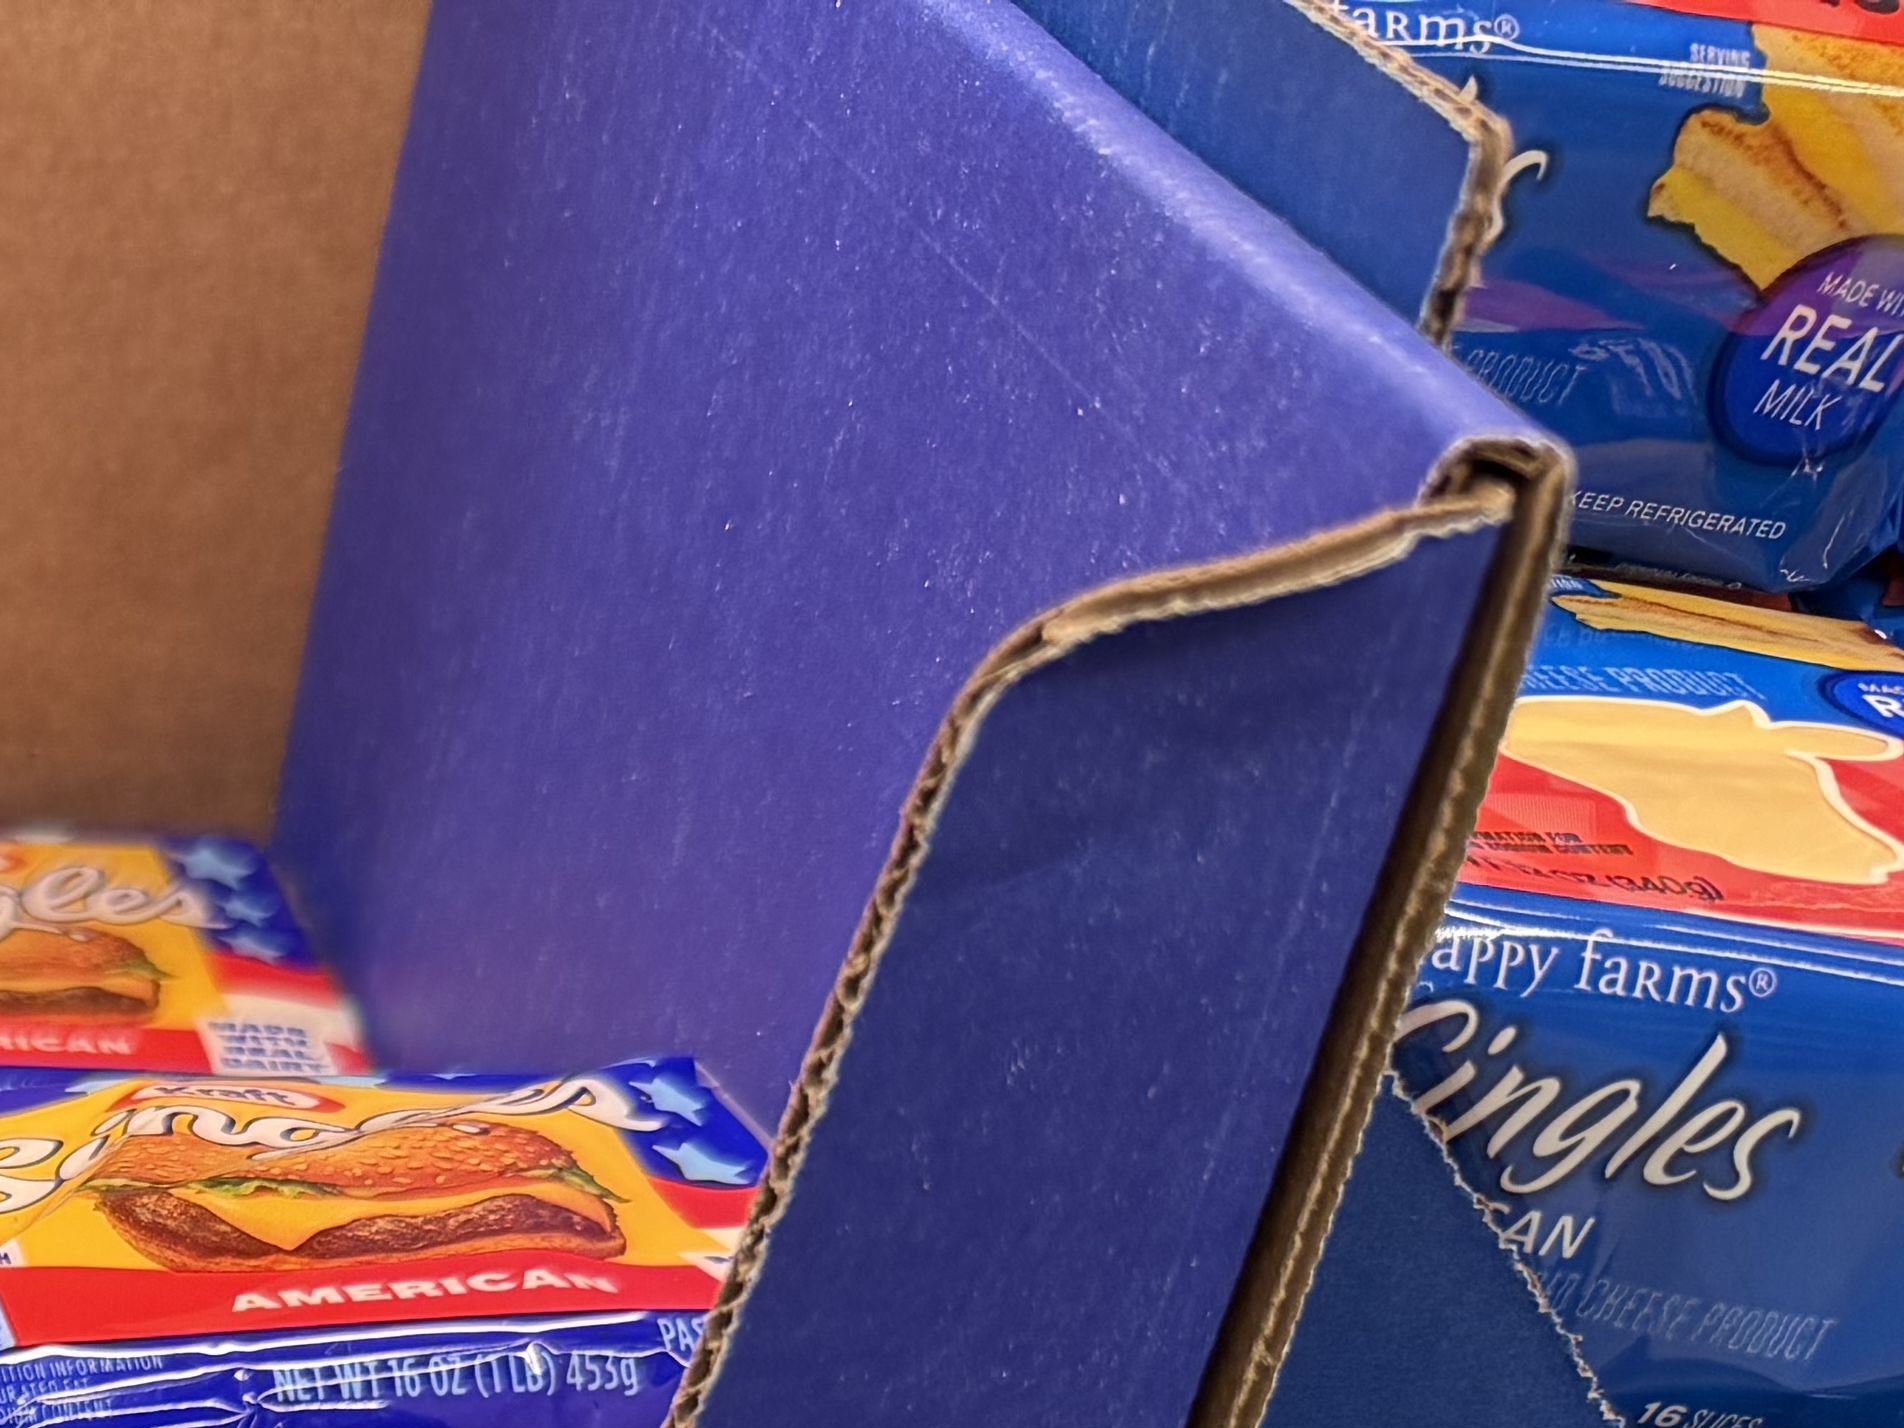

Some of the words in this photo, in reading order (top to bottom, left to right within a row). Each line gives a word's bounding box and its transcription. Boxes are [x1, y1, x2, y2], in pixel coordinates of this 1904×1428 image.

[1690, 43, 1751, 68] SERVING
[1816, 271, 1878, 307] MADE
[1760, 304, 1904, 393] REAL
[1753, 379, 1842, 431] MILK
[1625, 500, 1787, 540] REFRIGERATED
[1605, 666, 1766, 700] PRODUCT
[232, 1268, 620, 1313] AMERICAN
[1692, 1299, 1839, 1361] PRODUCT
[49, 1354, 163, 1380] INFORMATION
[274, 1365, 328, 1404] NET
[338, 1361, 384, 1402] WT
[393, 1357, 422, 1400] 16
[429, 1355, 467, 1398] OZ
[566, 1346, 639, 1396] 453g
[1638, 1402, 1688, 1428] 16
